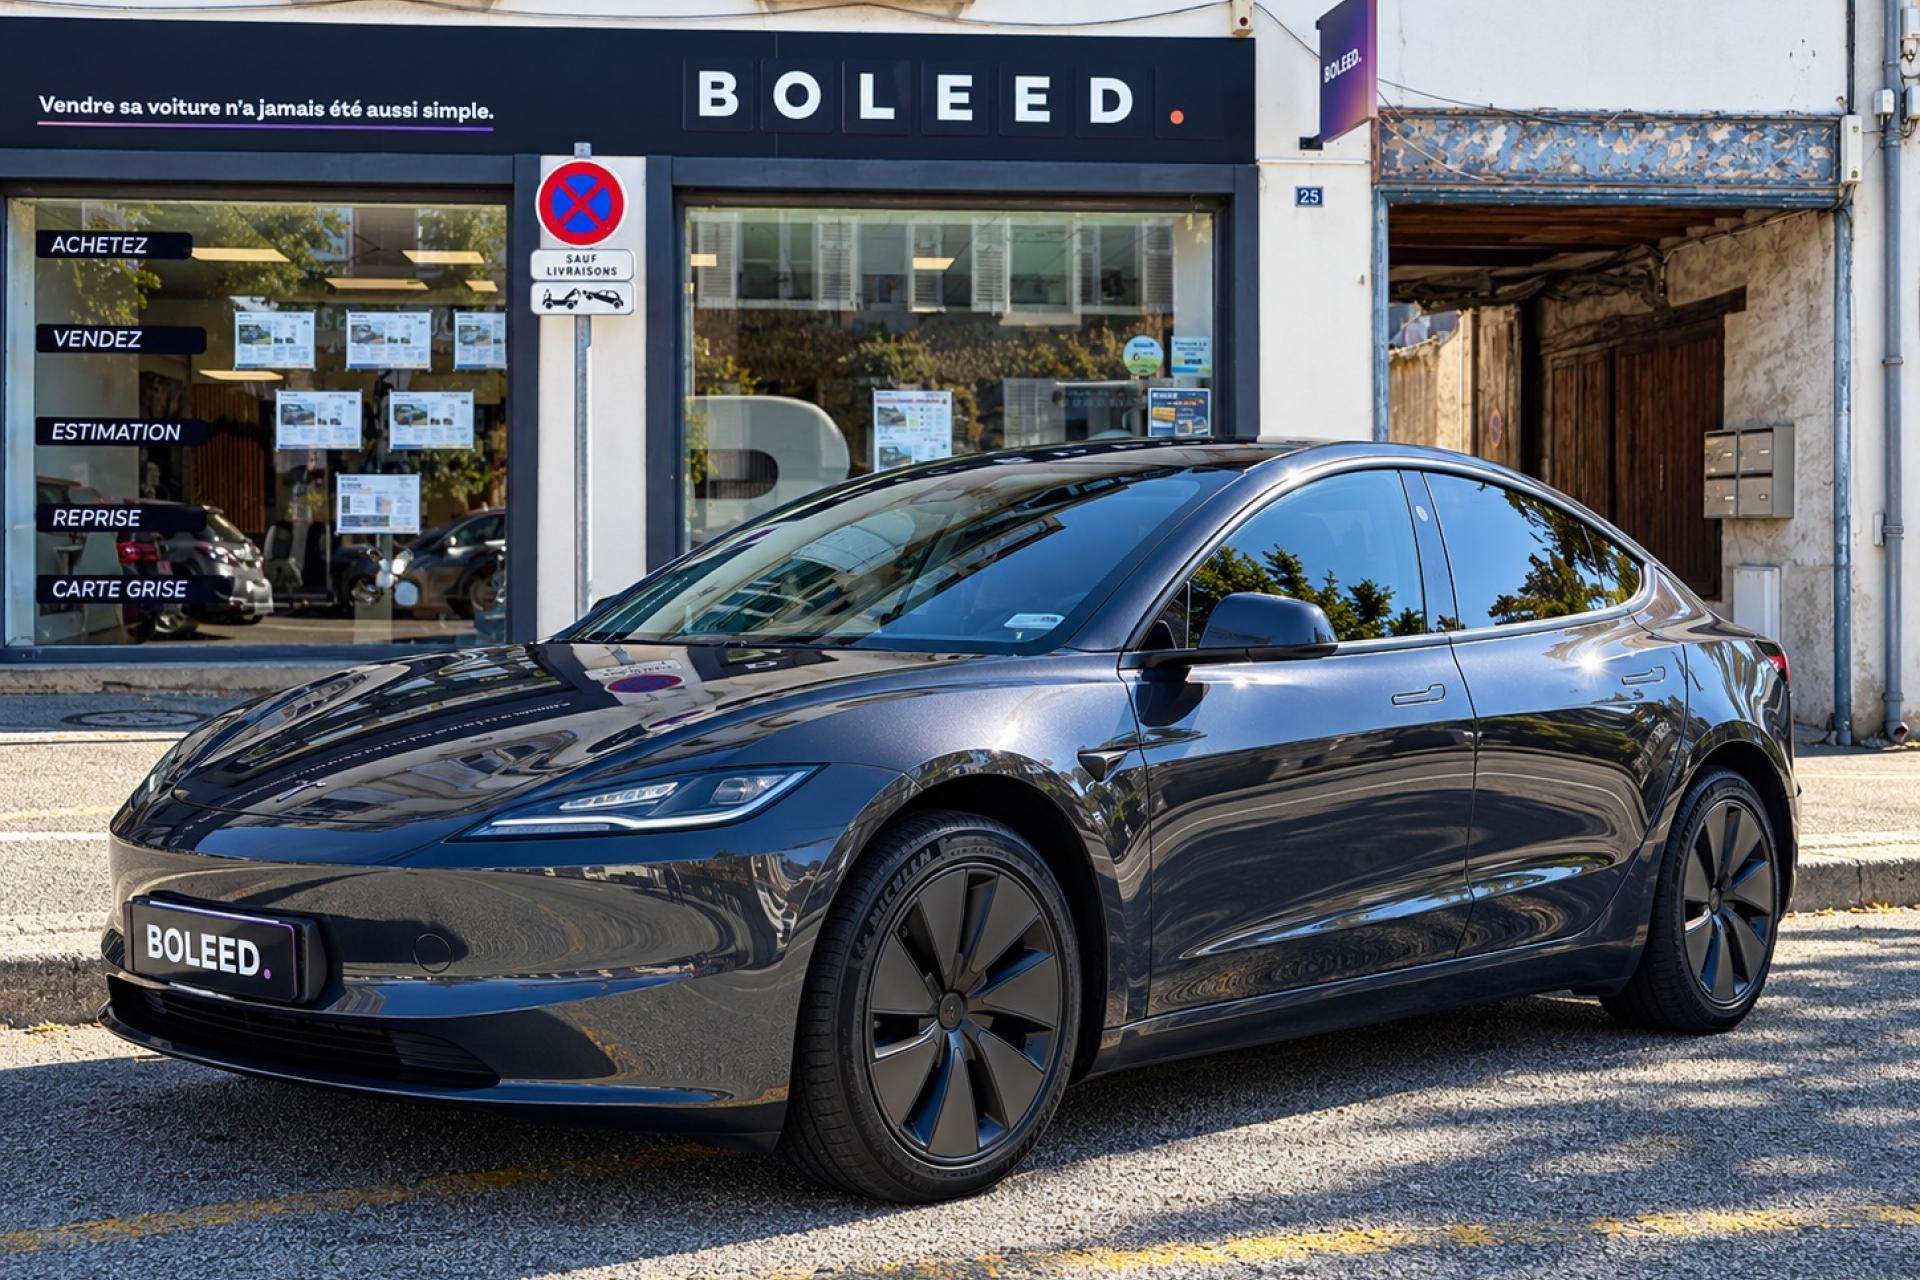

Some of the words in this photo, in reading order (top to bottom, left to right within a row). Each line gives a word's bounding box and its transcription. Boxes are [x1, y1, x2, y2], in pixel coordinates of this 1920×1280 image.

[1324, 48, 1362, 83] BOLEED.
[39, 95, 115, 114] Vendre
[119, 101, 144, 115] sa
[147, 98, 221, 116] voiture
[257, 100, 325, 121] jamais
[329, 100, 362, 118] été
[366, 101, 418, 119] aussi
[422, 101, 494, 122] simple.
[1300, 189, 1319, 204] 25
[51, 236, 148, 254] ACHETEZ
[566, 254, 597, 264] SAUF
[546, 266, 618, 276] LIVRAISONS
[53, 330, 142, 348] VENDEZ
[52, 423, 181, 441] ESTIMATION
[53, 509, 141, 527] REPRISE
[53, 580, 122, 598] CARTE
[126, 580, 188, 598] GRISE
[146, 923, 272, 980] BOLEED.
